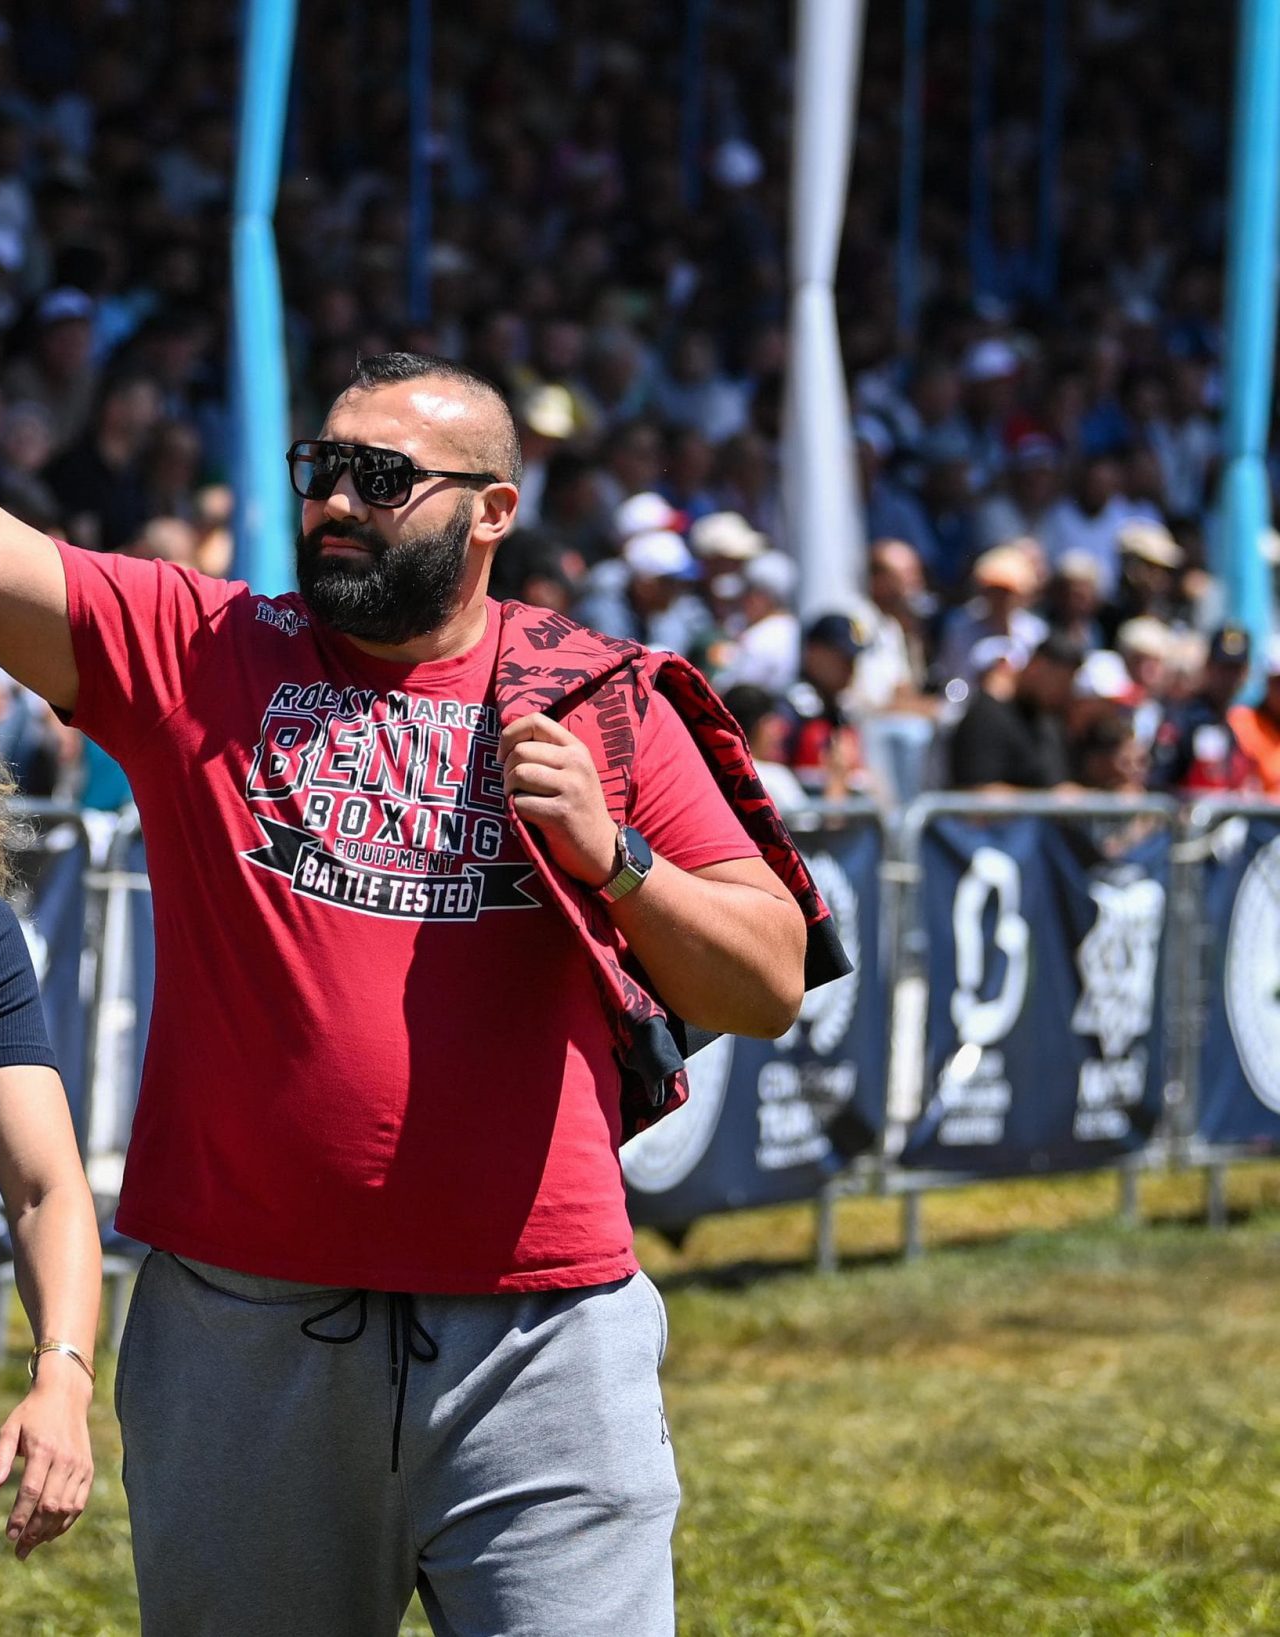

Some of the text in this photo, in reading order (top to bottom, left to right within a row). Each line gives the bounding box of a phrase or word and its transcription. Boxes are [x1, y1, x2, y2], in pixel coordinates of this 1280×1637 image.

[268, 681, 377, 717] ROCKY
[302, 792, 503, 860] BOXING
[333, 838, 456, 875] EQUIPMENT
[301, 854, 474, 915] BATTLE TESTED
